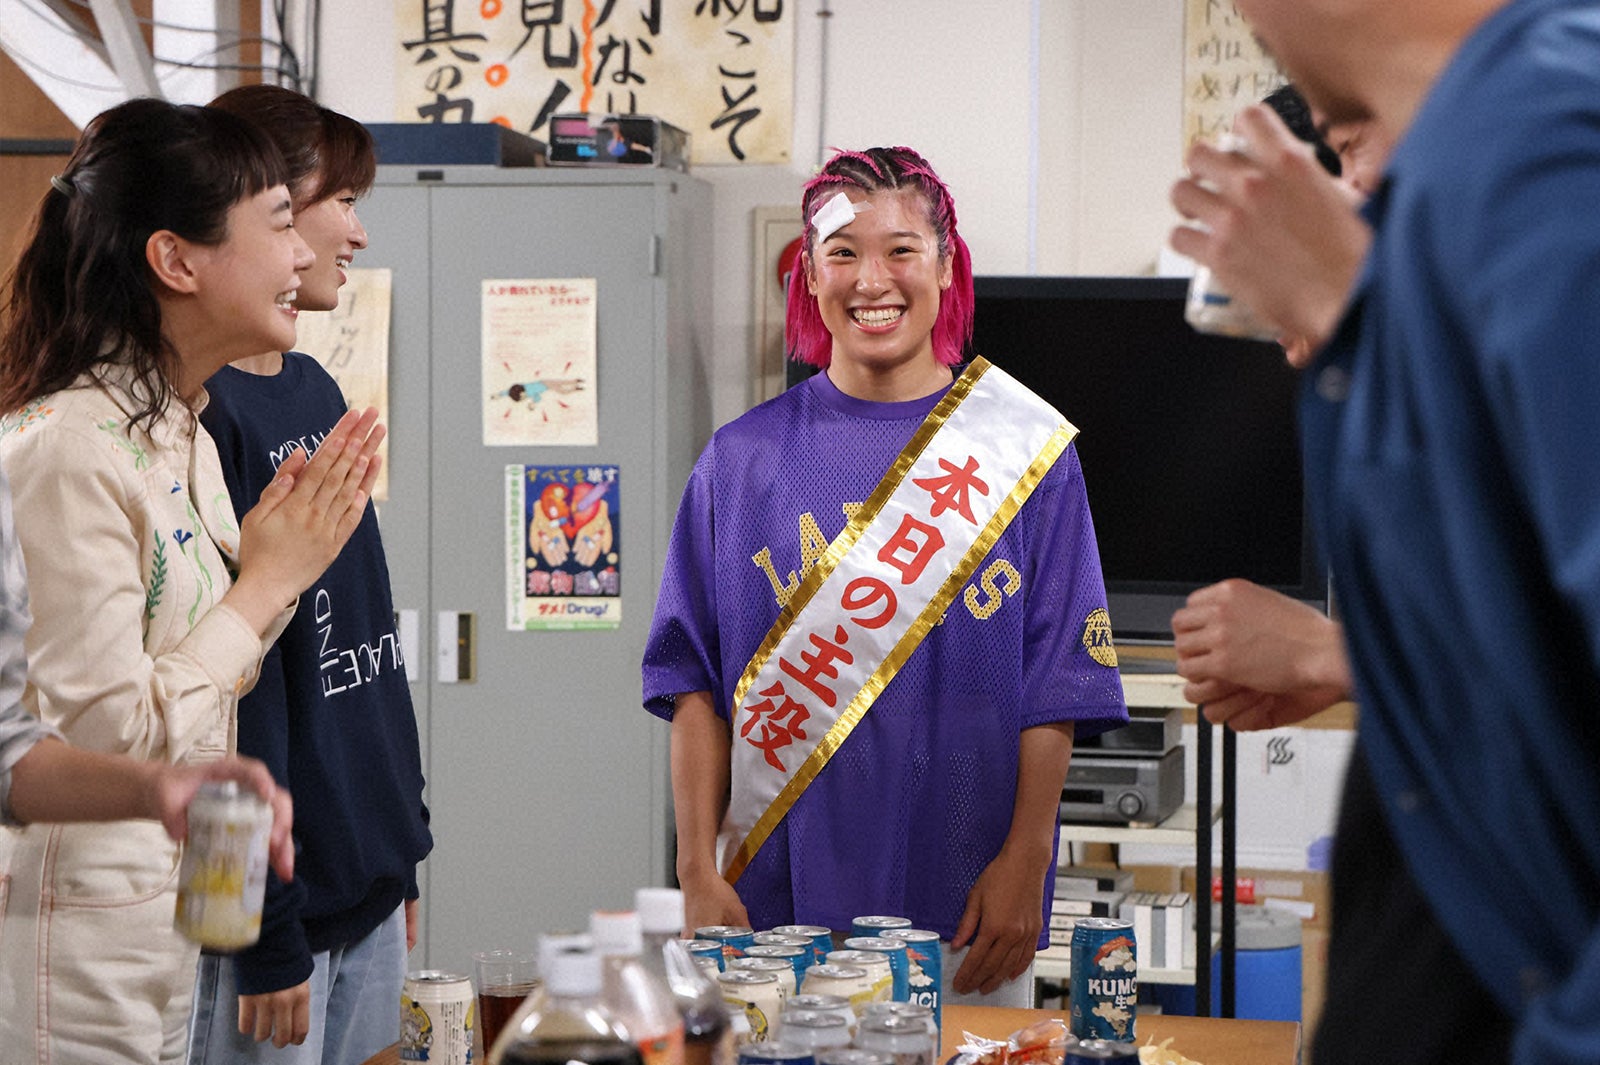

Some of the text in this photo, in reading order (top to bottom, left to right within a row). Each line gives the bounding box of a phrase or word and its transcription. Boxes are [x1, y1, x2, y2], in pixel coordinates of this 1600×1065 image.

[527, 467, 618, 483] すべてを壊す
[315, 588, 347, 698] FIND
[741, 455, 990, 773] 本日の主役
[1115, 995, 1127, 1009] 生
